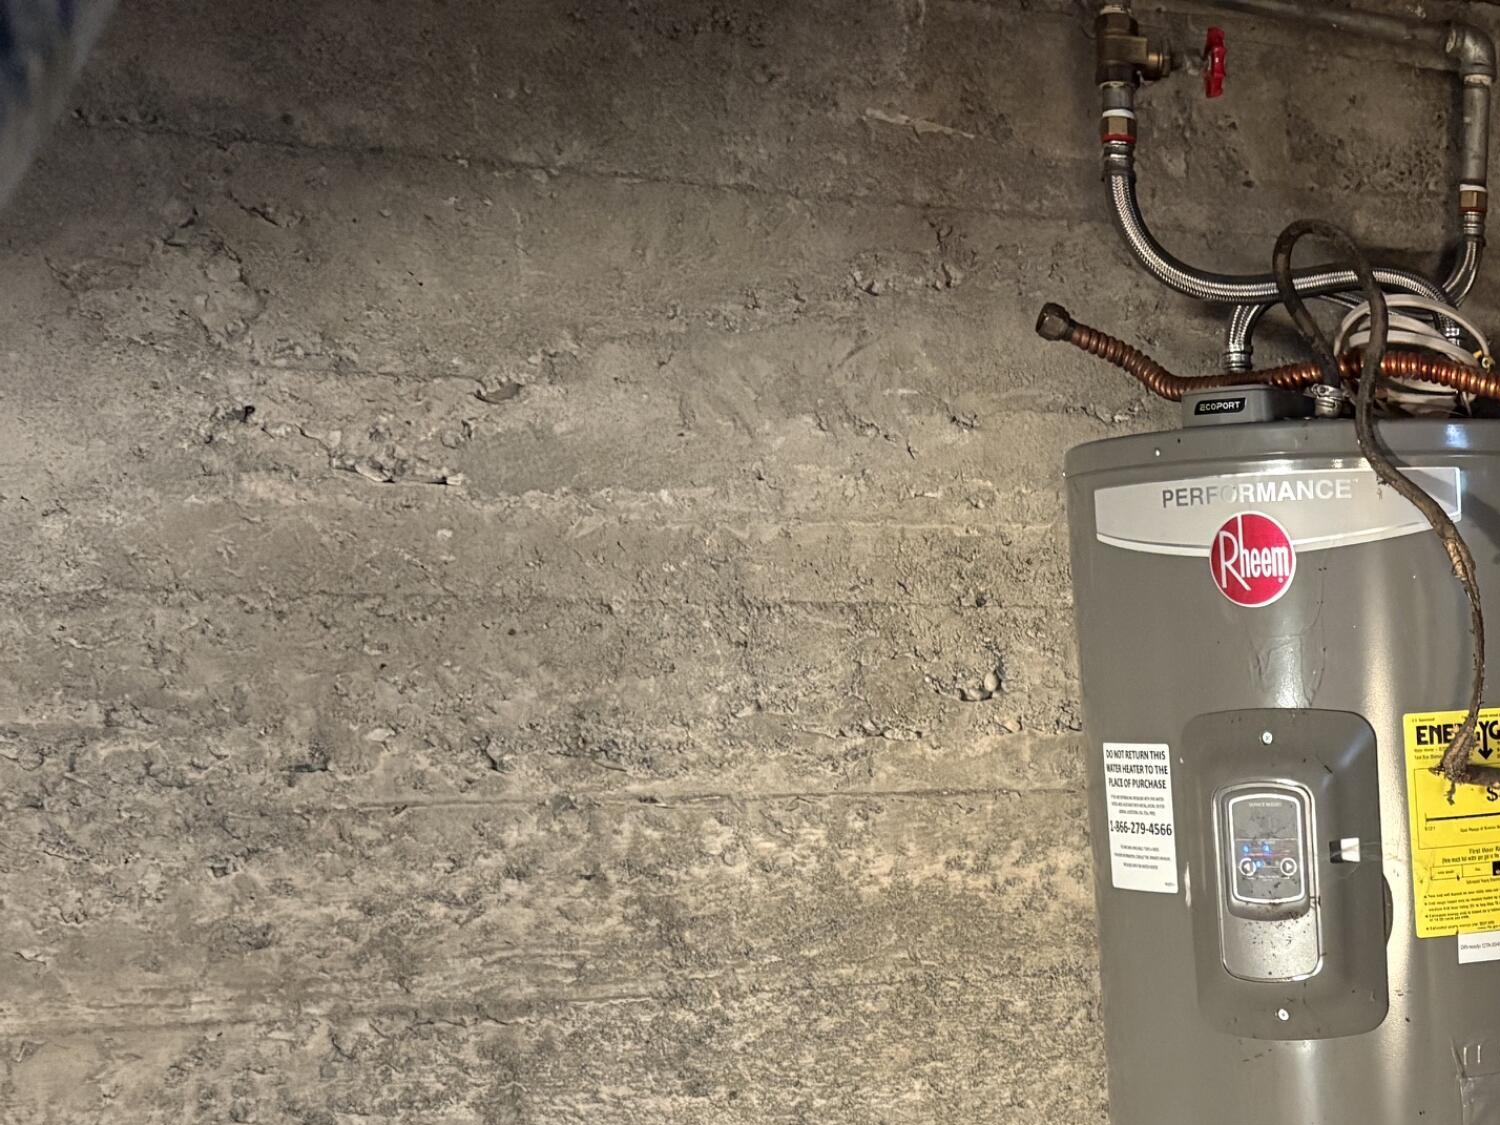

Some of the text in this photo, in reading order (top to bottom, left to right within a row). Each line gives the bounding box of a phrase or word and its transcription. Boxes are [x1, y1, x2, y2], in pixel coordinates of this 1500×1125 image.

[1199, 401, 1240, 411] ECOPORT
[1162, 478, 1353, 508] PERFORMANCE
[1218, 514, 1291, 591] Rheem
[1114, 749, 1124, 759] NOT
[1125, 750, 1149, 760] RETURN
[1150, 750, 1166, 760] THIS
[1123, 764, 1144, 774] HEATER
[1145, 764, 1154, 774] TO
[1155, 765, 1168, 775] THE
[1108, 777, 1167, 789] PLACE OF PURCHASE
[1110, 820, 1173, 836] 1-866-279-4566
